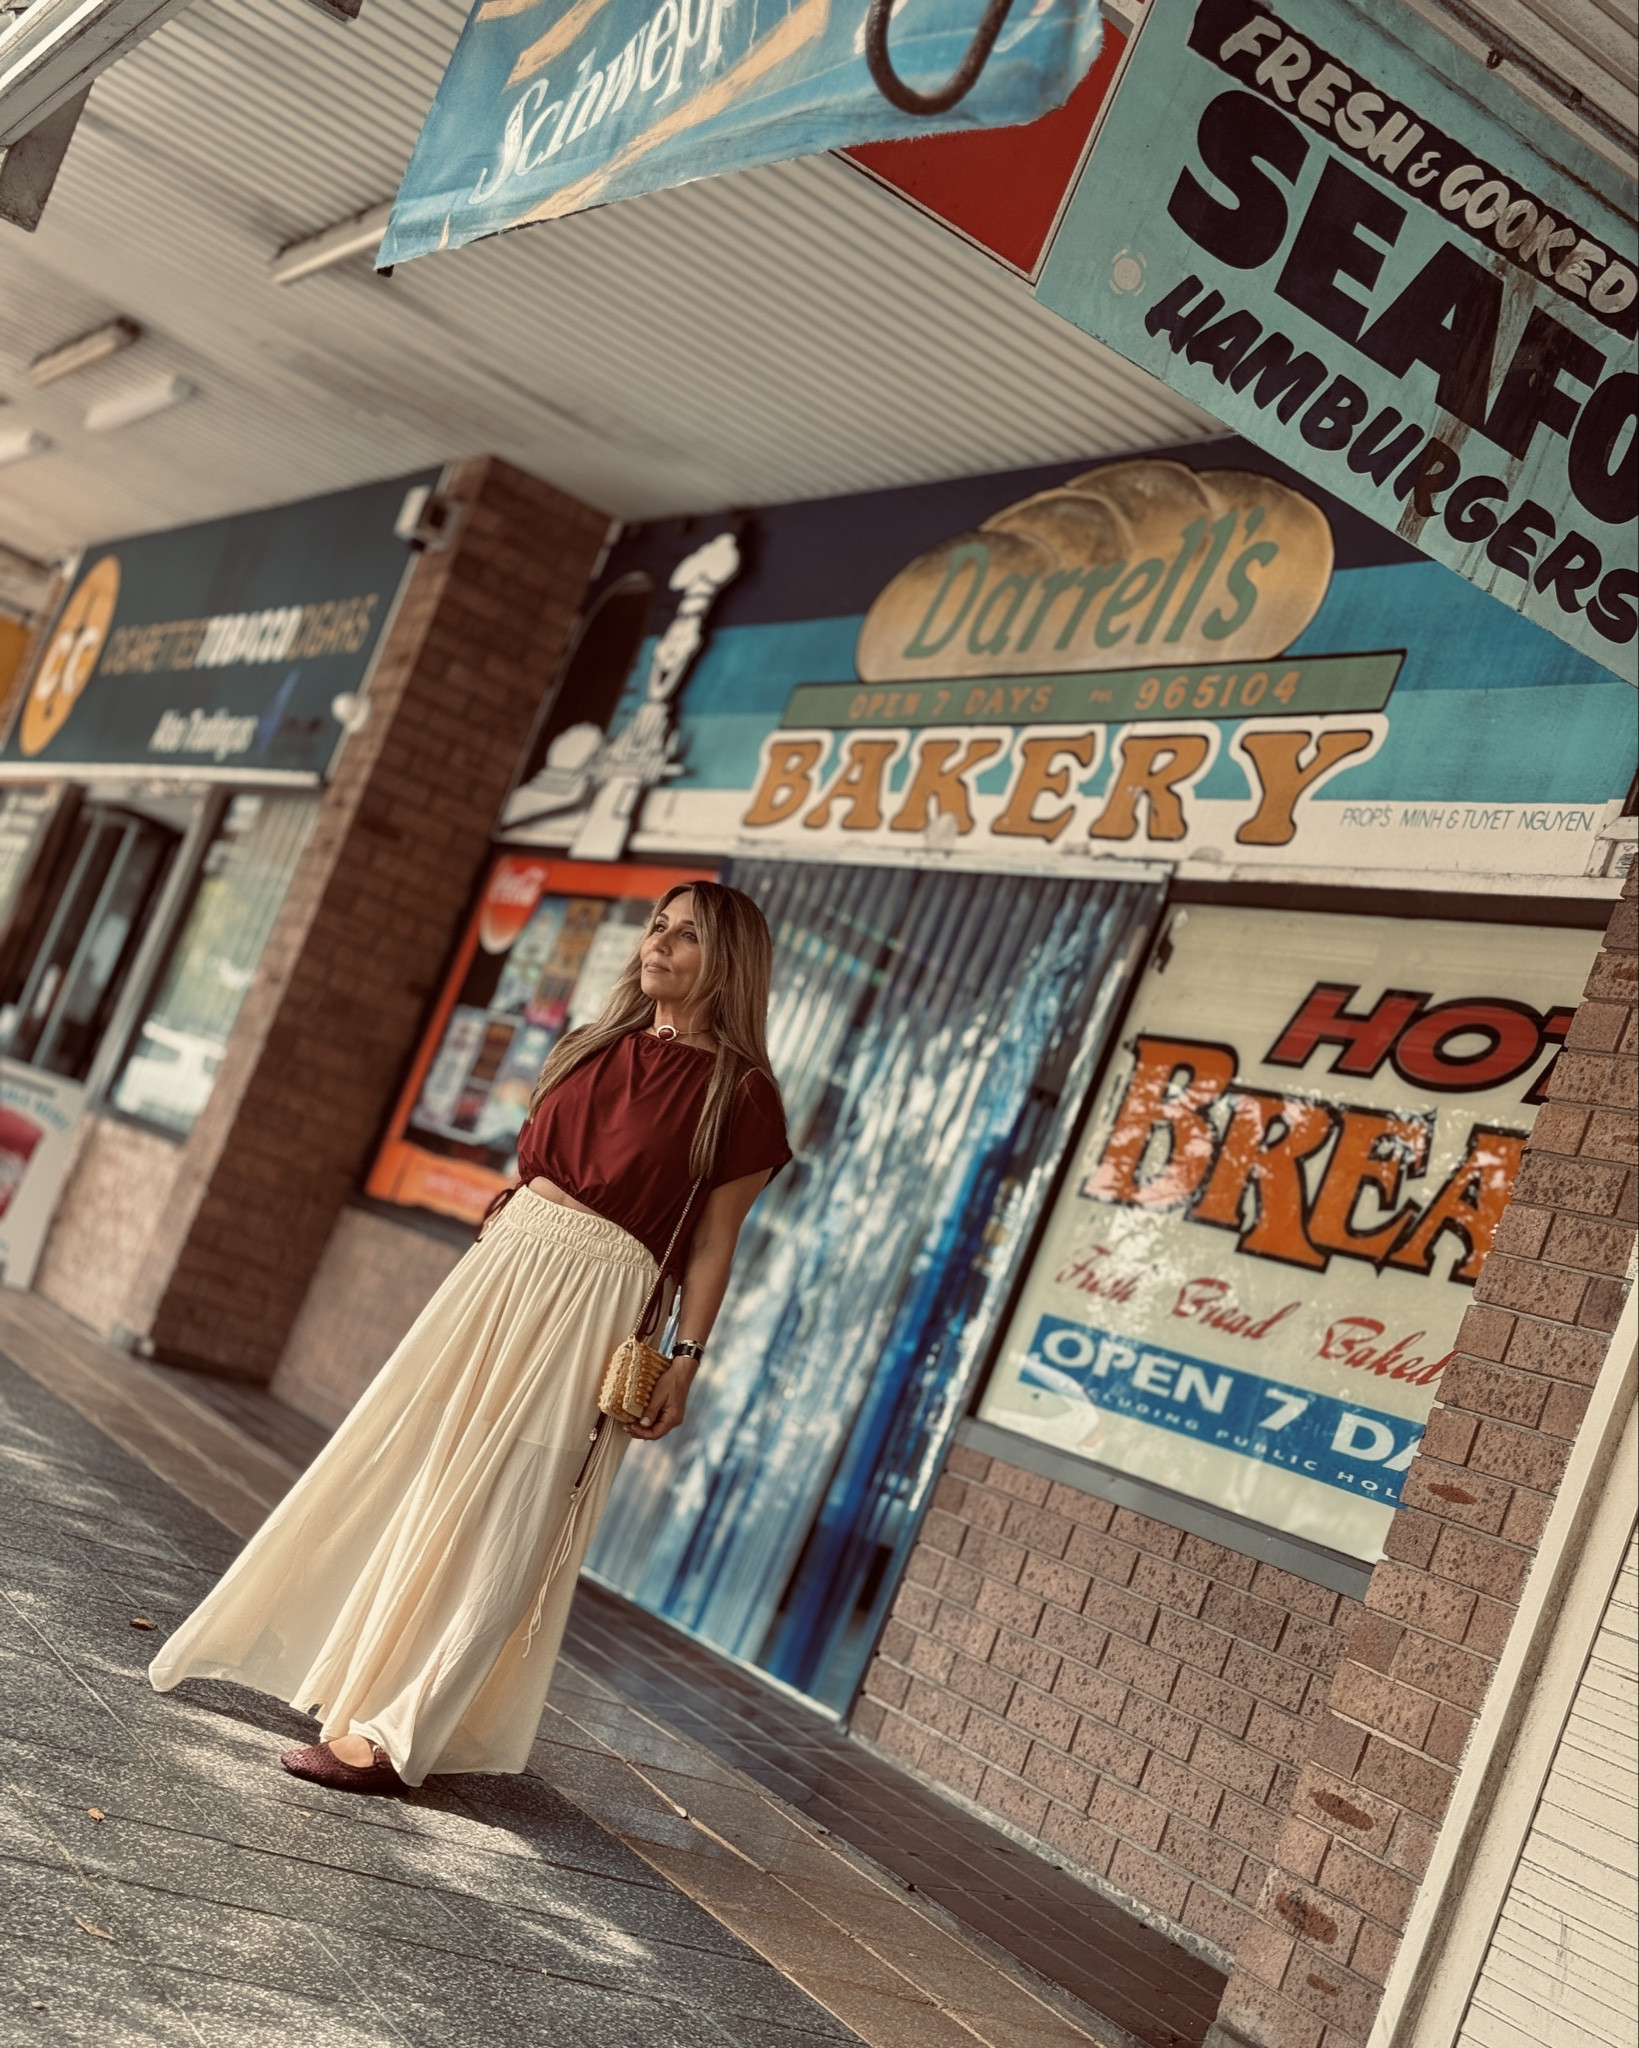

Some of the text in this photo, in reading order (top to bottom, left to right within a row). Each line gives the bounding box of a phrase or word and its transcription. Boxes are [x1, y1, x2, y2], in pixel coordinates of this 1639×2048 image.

[1219, 14, 1638, 313] FRESH & COOKED
[1167, 90, 1638, 524] SEAFO
[1144, 274, 1638, 644] HAMBURGERS
[902, 506, 1280, 661] Darrell's
[848, 691, 921, 720] OPEN
[932, 690, 952, 716] 7
[963, 684, 1054, 715] DAYS
[1133, 670, 1300, 712] 965104
[740, 729, 1374, 847] BAKERY
[1400, 808, 1445, 830] MINH
[1446, 809, 1460, 830] &
[1461, 809, 1514, 831] TUYET
[1042, 1328, 1234, 1415] OPEN
[1258, 1386, 1308, 1432] 7
[1171, 1277, 1302, 1341] Bread
[1315, 1316, 1460, 1387] Baked
[1216, 1429, 1317, 1471] PUBLIC
